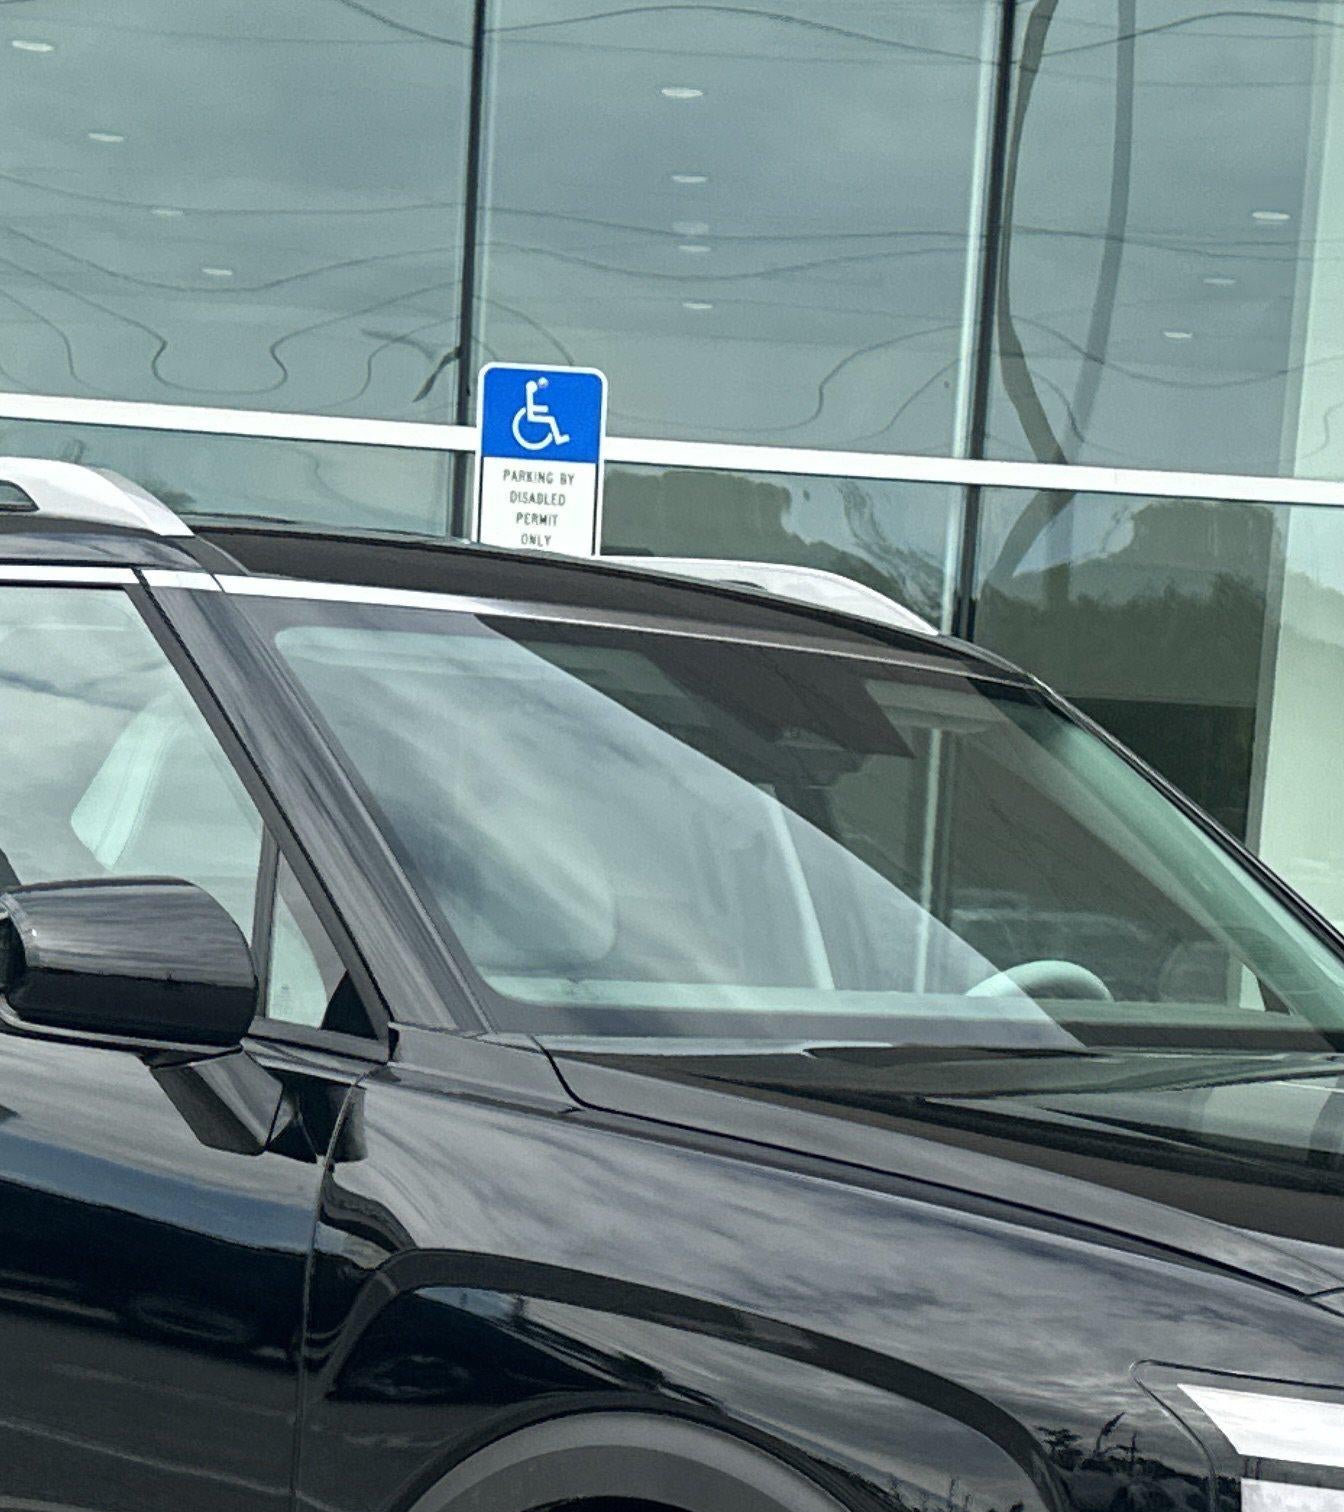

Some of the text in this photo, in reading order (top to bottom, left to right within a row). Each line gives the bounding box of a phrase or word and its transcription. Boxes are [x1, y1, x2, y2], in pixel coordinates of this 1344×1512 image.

[503, 469, 575, 485] PARKING BY
[509, 490, 566, 506] DISABLED
[516, 511, 558, 527] PERMIT
[521, 533, 552, 547] ONLY
